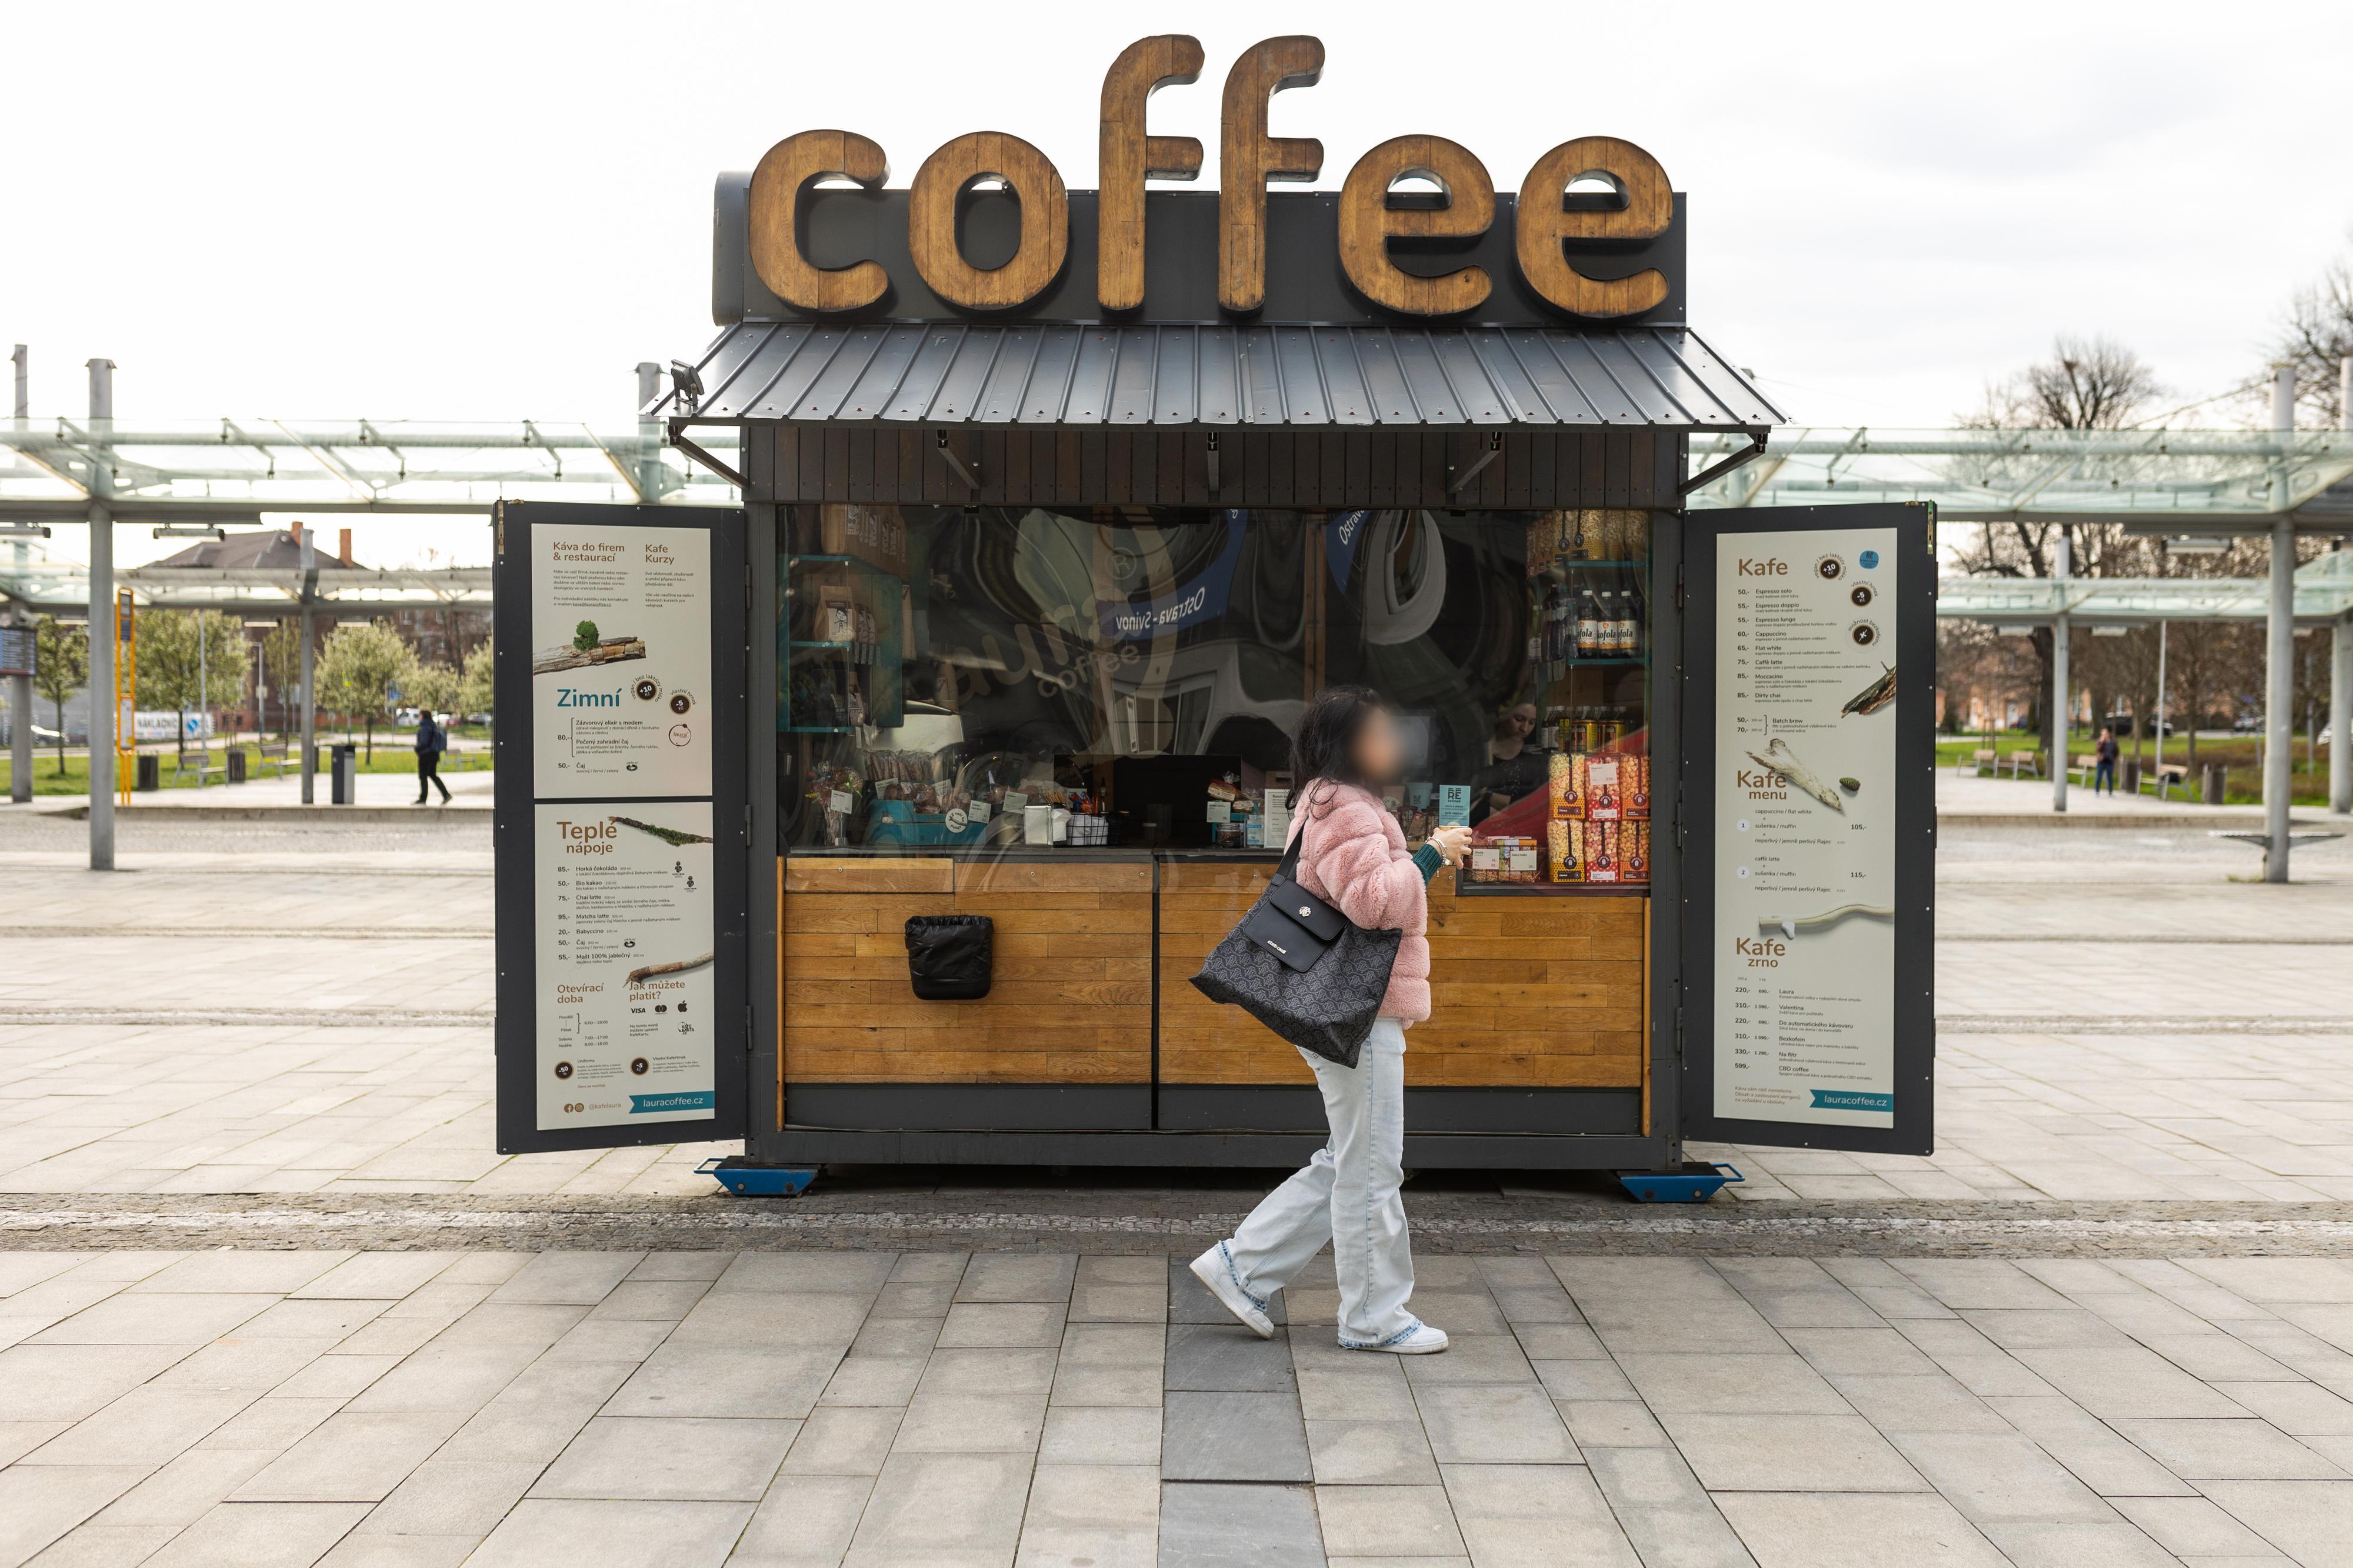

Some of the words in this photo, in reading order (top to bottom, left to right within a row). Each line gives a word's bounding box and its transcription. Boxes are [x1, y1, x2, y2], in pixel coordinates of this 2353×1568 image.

[749, 35, 1673, 318] coffee
[554, 542, 578, 551] Káva
[582, 543, 595, 551] do
[598, 543, 624, 552] firem
[646, 544, 668, 553] Kafe
[554, 552, 561, 561] &
[565, 553, 616, 562] restaurací
[646, 554, 674, 565] Kurzy
[1739, 558, 1788, 576] Kafe
[1038, 644, 1140, 698] coffee
[557, 688, 622, 707] Zimní
[1738, 769, 1788, 788] Kafe
[1749, 792, 1787, 800] menu
[556, 820, 617, 843] Teplé
[566, 841, 612, 855] nápoje
[1737, 938, 1785, 956] Kafe
[1748, 959, 1778, 968] zrno
[558, 983, 604, 993] Otevírací
[629, 980, 645, 990] Jak
[647, 979, 685, 989] můžete
[558, 995, 583, 1003] doba
[630, 991, 661, 1002] platit?
[644, 1097, 703, 1107] lauracoffee.cz
[1825, 1095, 1887, 1106] lauracoffee.cz
